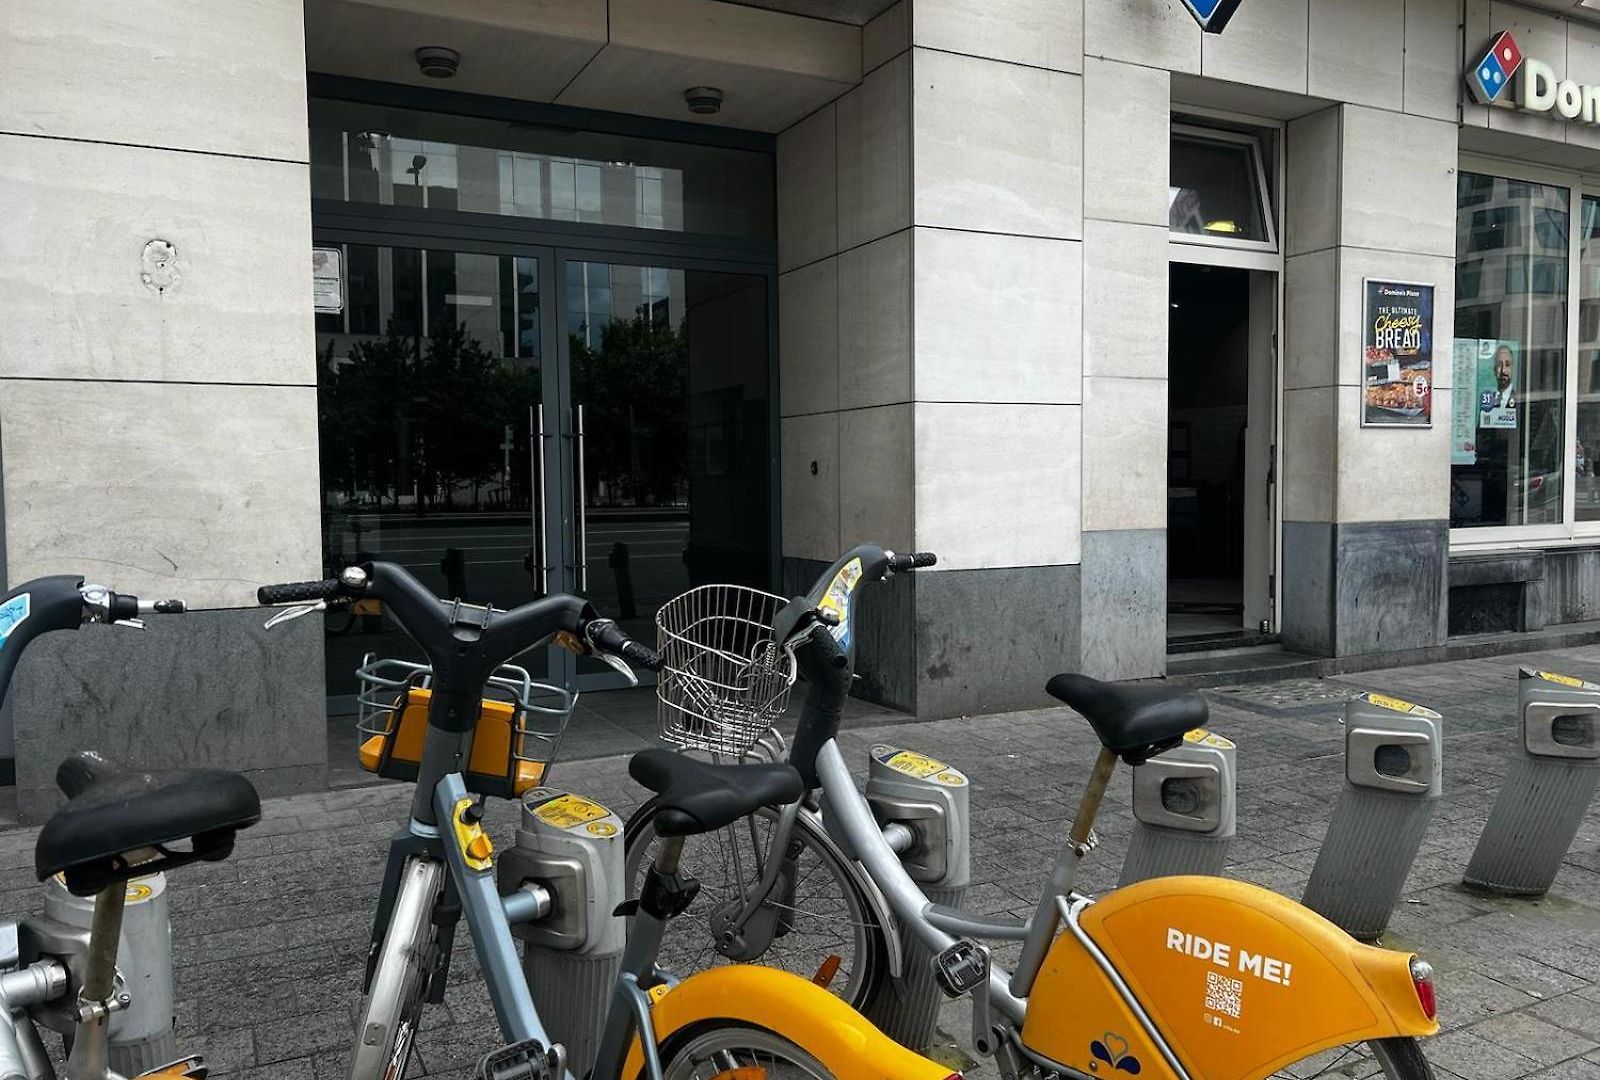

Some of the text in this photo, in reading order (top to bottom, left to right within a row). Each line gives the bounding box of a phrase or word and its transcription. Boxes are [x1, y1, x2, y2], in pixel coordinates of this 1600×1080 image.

[1375, 313, 1422, 334] Cheesy
[1376, 329, 1420, 349] BREAD
[1166, 928, 1292, 986] RIDE ME!
